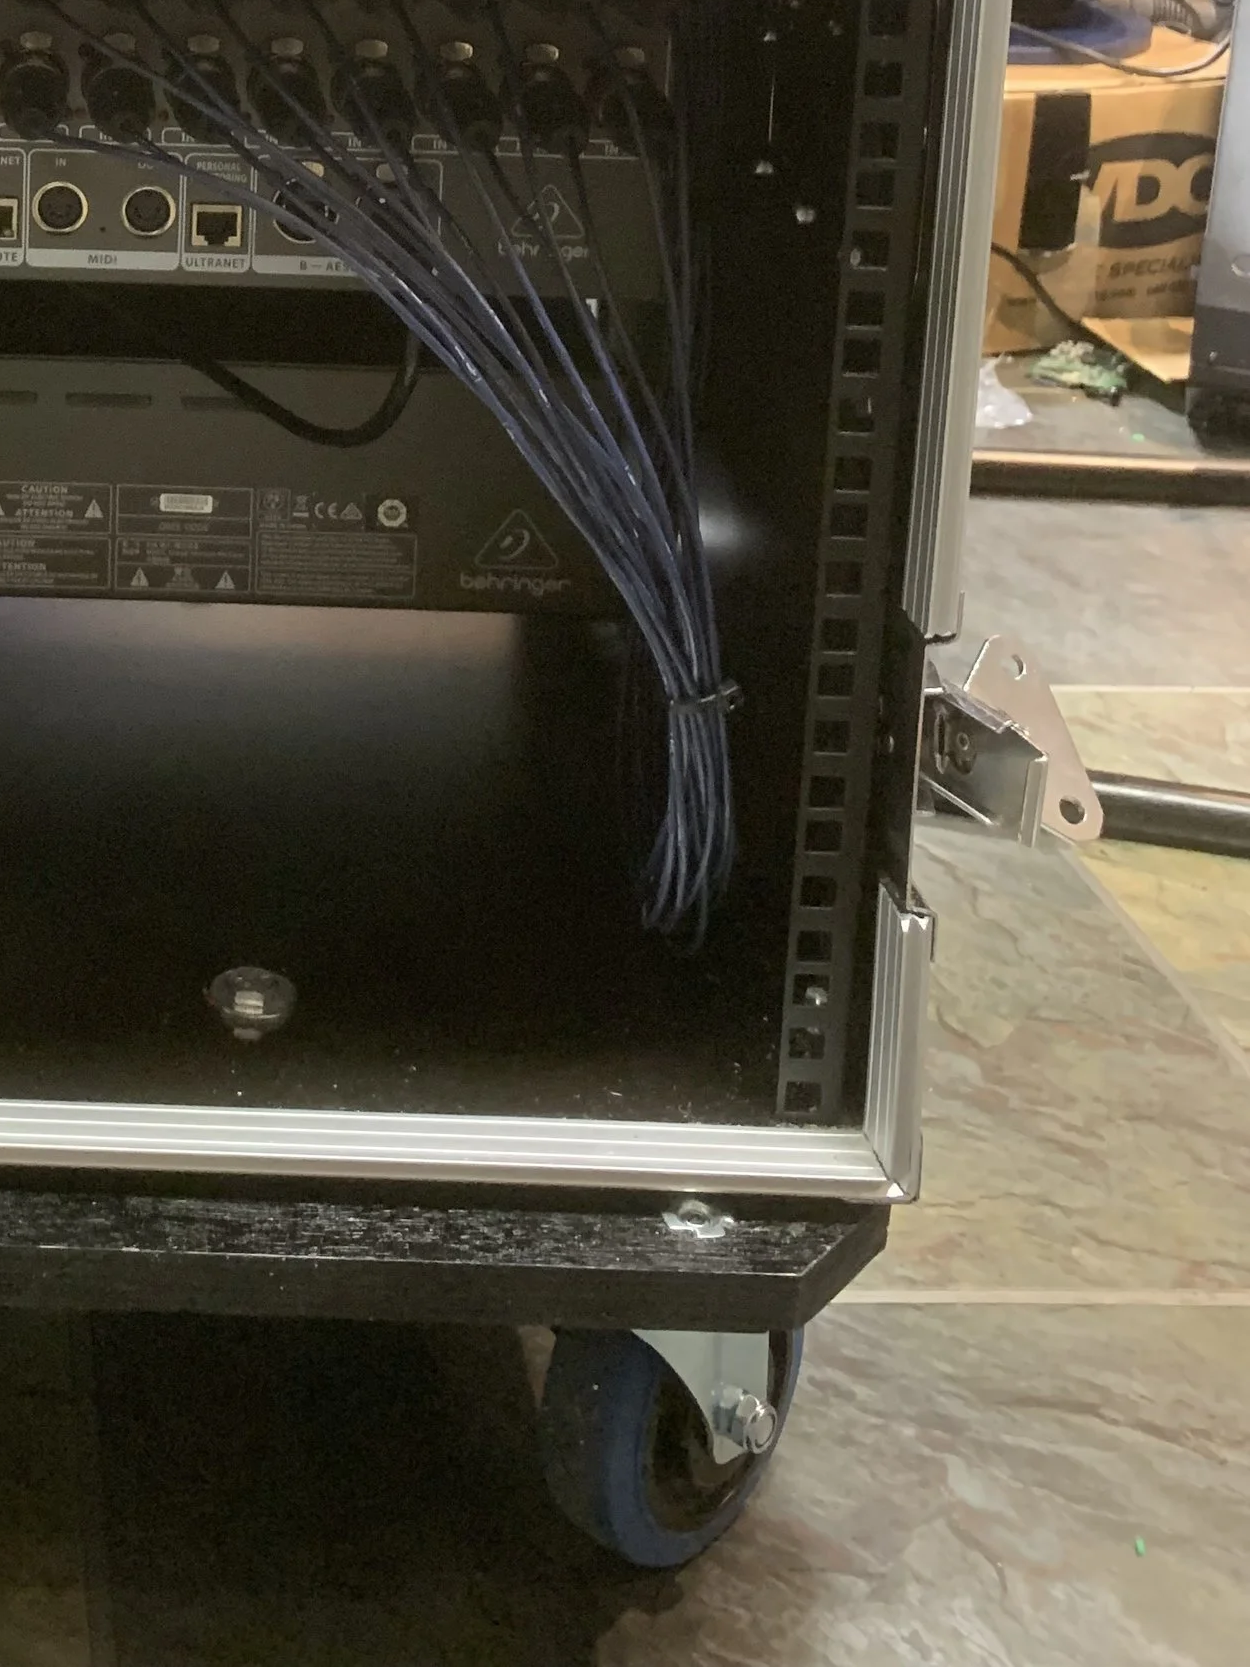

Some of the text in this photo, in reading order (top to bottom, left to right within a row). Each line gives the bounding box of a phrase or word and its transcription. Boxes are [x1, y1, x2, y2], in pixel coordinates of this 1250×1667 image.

[55, 157, 67, 167] IN
[196, 161, 241, 172] PERSONAL
[498, 240, 589, 262] behrger
[87, 253, 117, 265] MIDI
[185, 257, 246, 269] ULTRANET
[21, 484, 68, 494] CAUTION
[15, 508, 74, 518] ATTENTION
[459, 572, 571, 597] behringer
